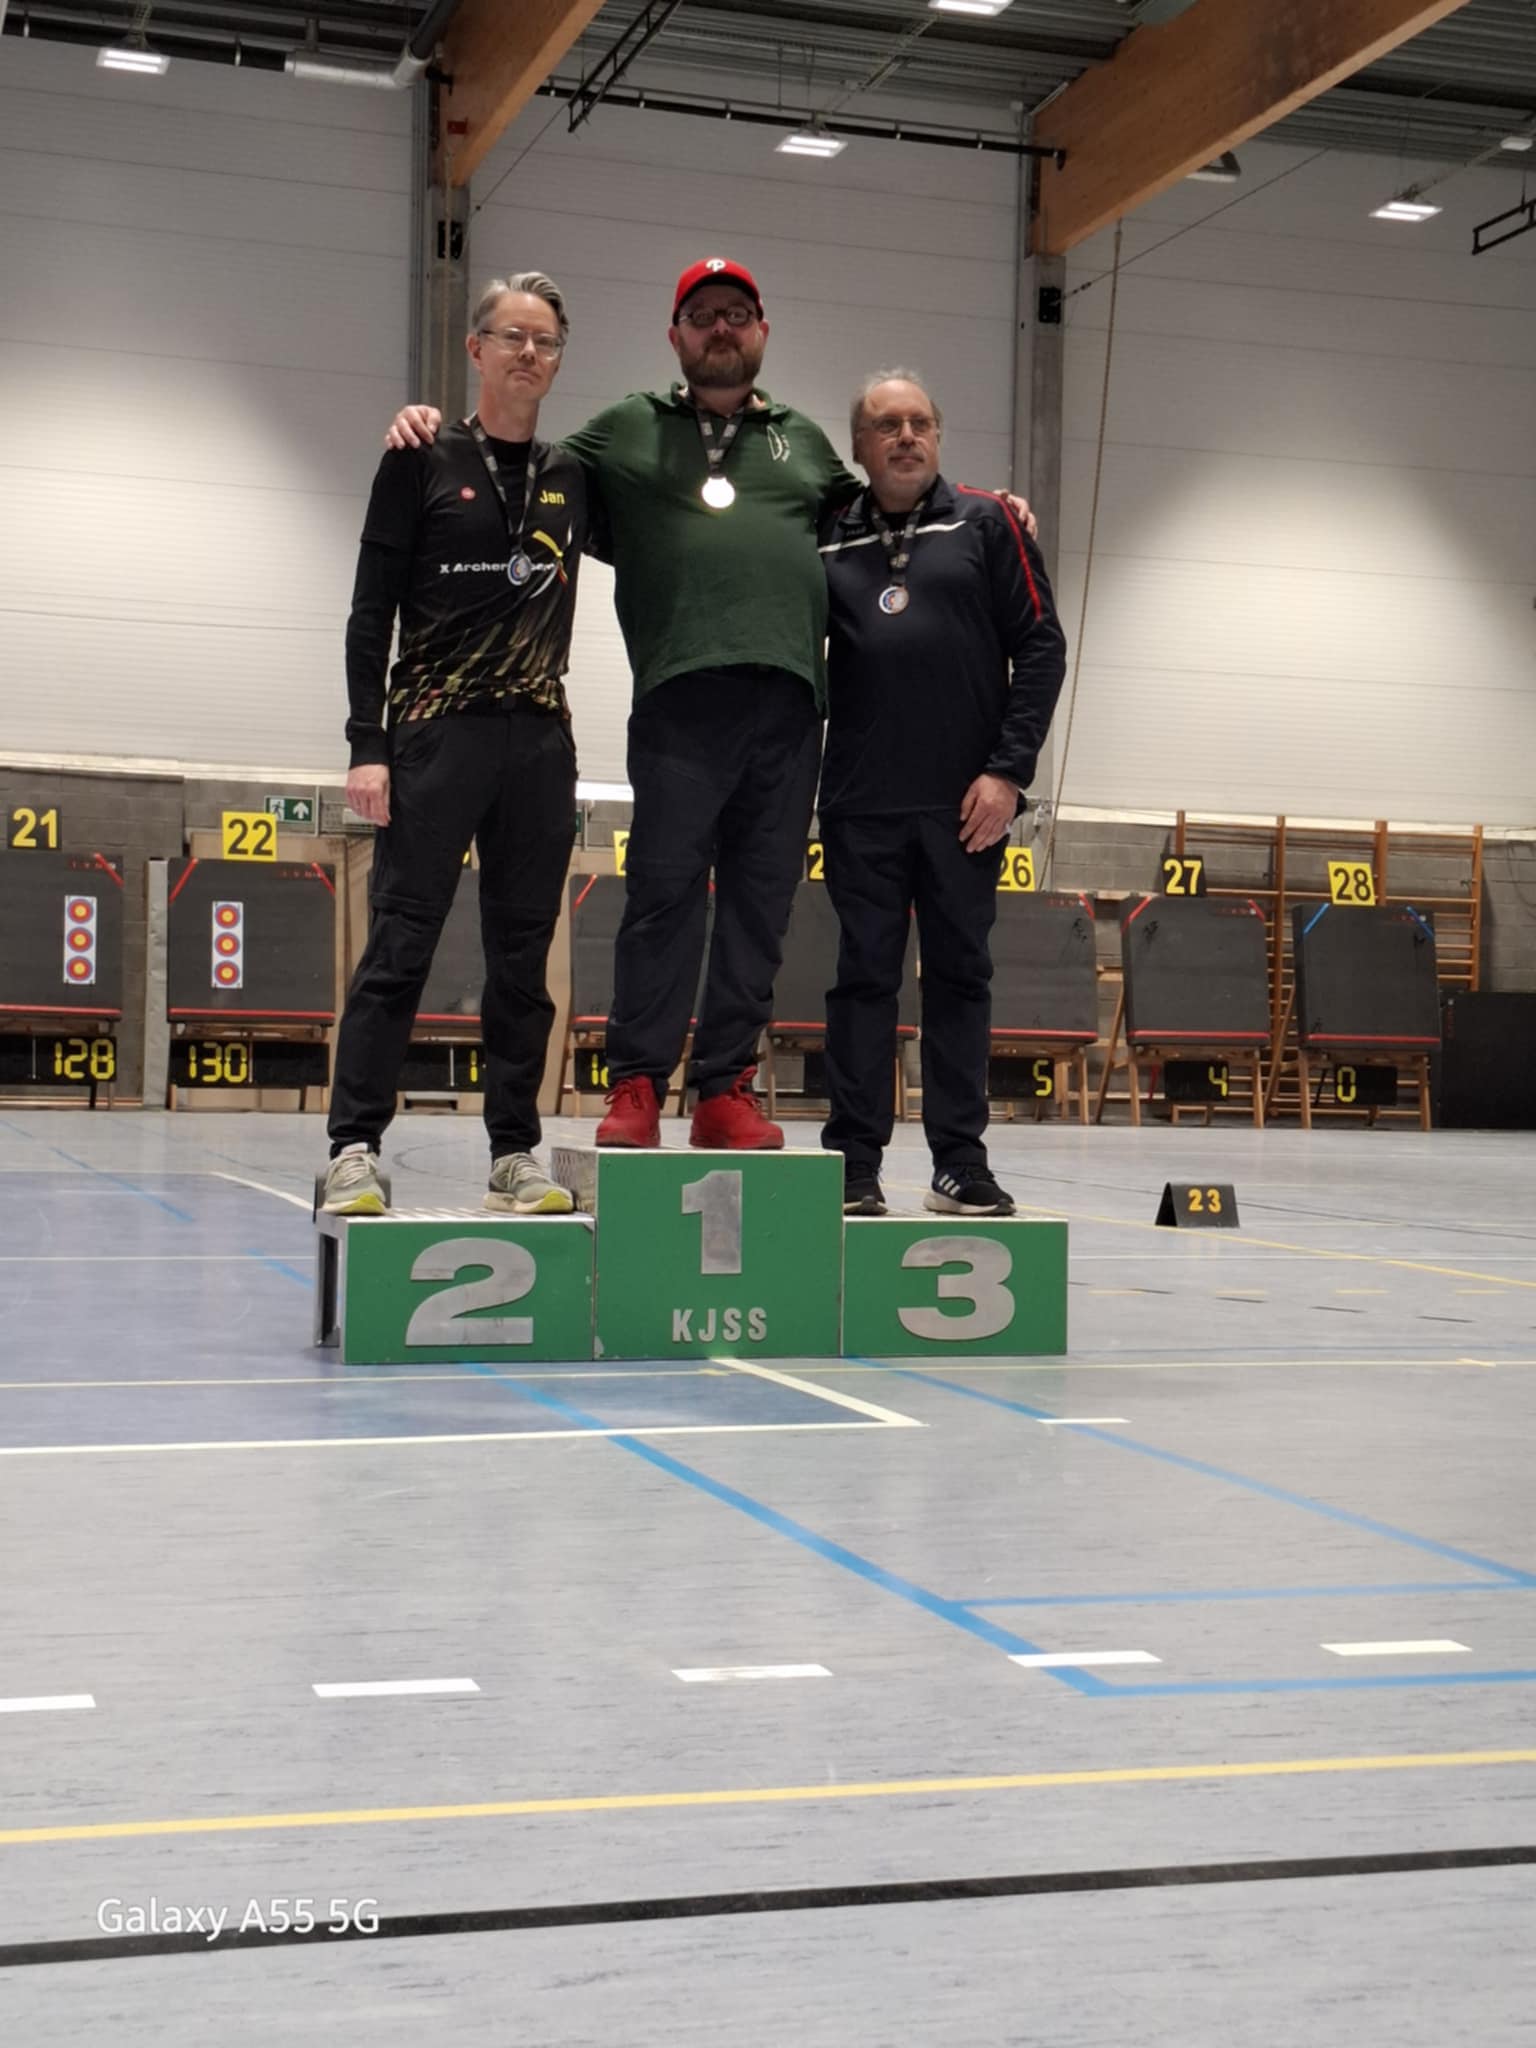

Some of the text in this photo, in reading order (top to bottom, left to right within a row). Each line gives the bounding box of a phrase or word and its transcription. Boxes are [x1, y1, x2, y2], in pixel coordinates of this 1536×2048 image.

[539, 490, 565, 505] Jan
[12, 808, 57, 848] 21
[227, 818, 273, 856] 22
[808, 843, 825, 880] 2
[997, 853, 1031, 888] 26
[1163, 859, 1202, 895] 27
[1333, 867, 1371, 902] 28
[54, 1039, 116, 1080] 128
[189, 1042, 248, 1083] 130
[1033, 1059, 1052, 1096] 5
[1208, 1066, 1227, 1096] 4
[1337, 1067, 1356, 1102] 0
[1188, 1188, 1222, 1213] 23
[682, 1170, 743, 1274] 1
[405, 1237, 536, 1346] 2
[898, 1235, 1015, 1341] 3
[672, 1307, 768, 1343] KJSS
